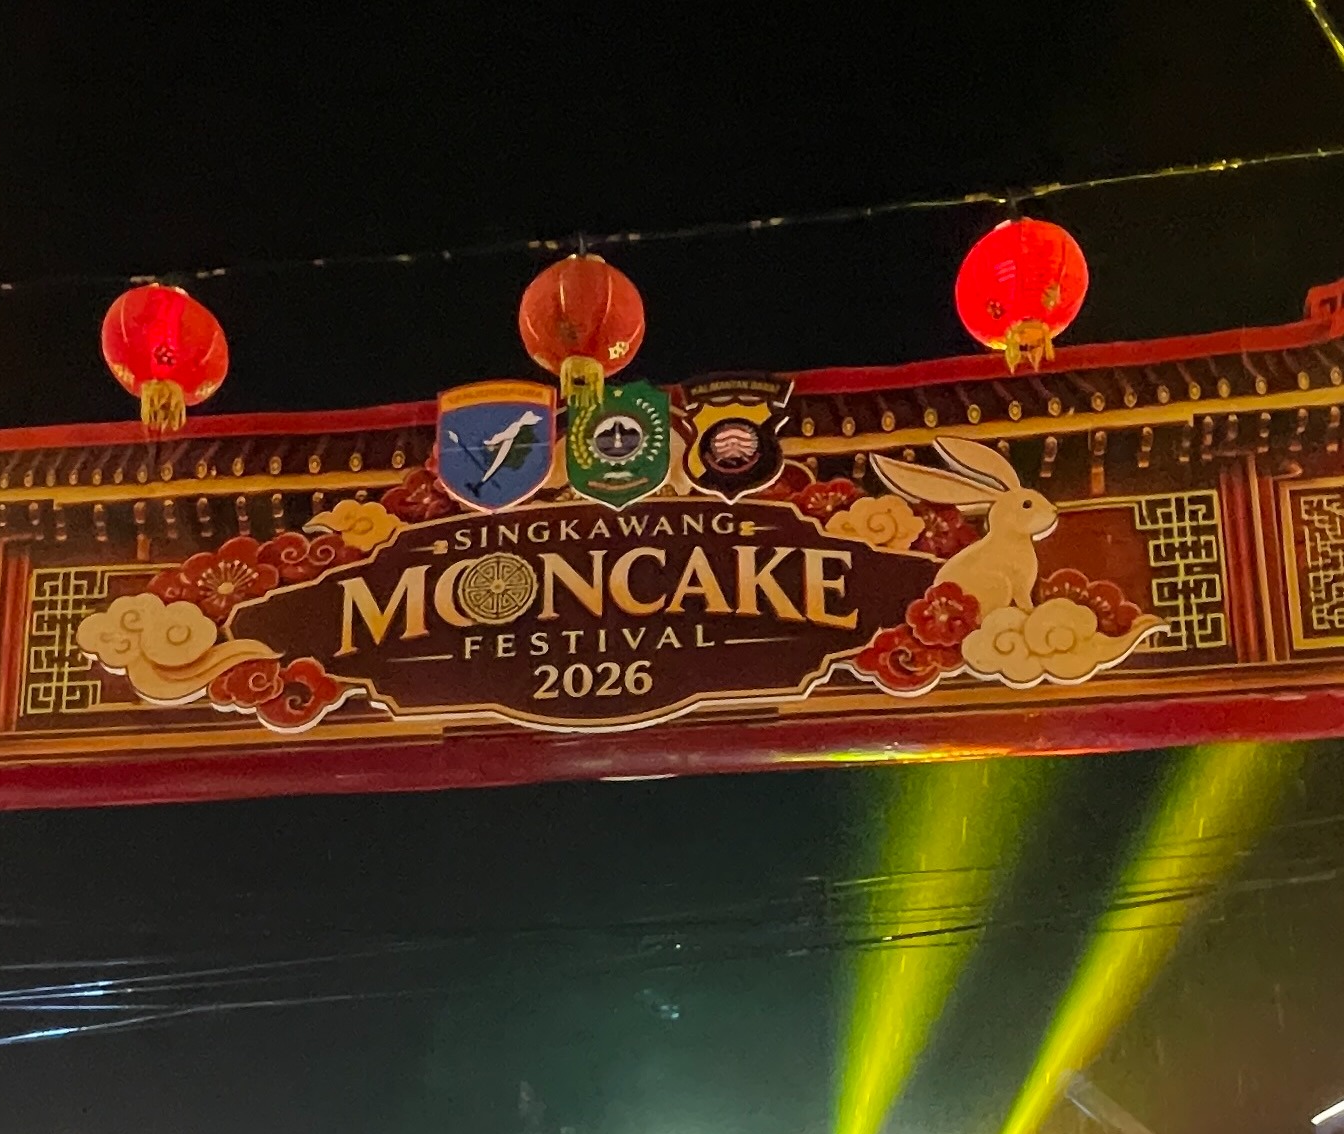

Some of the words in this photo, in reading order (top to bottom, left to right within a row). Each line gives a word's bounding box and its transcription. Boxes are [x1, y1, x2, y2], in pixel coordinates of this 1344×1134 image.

[454, 512, 734, 550] SINGKAWANG
[333, 545, 858, 658] MOONCAKE
[464, 624, 715, 660] FESTIVAL
[533, 660, 653, 700] 2026
